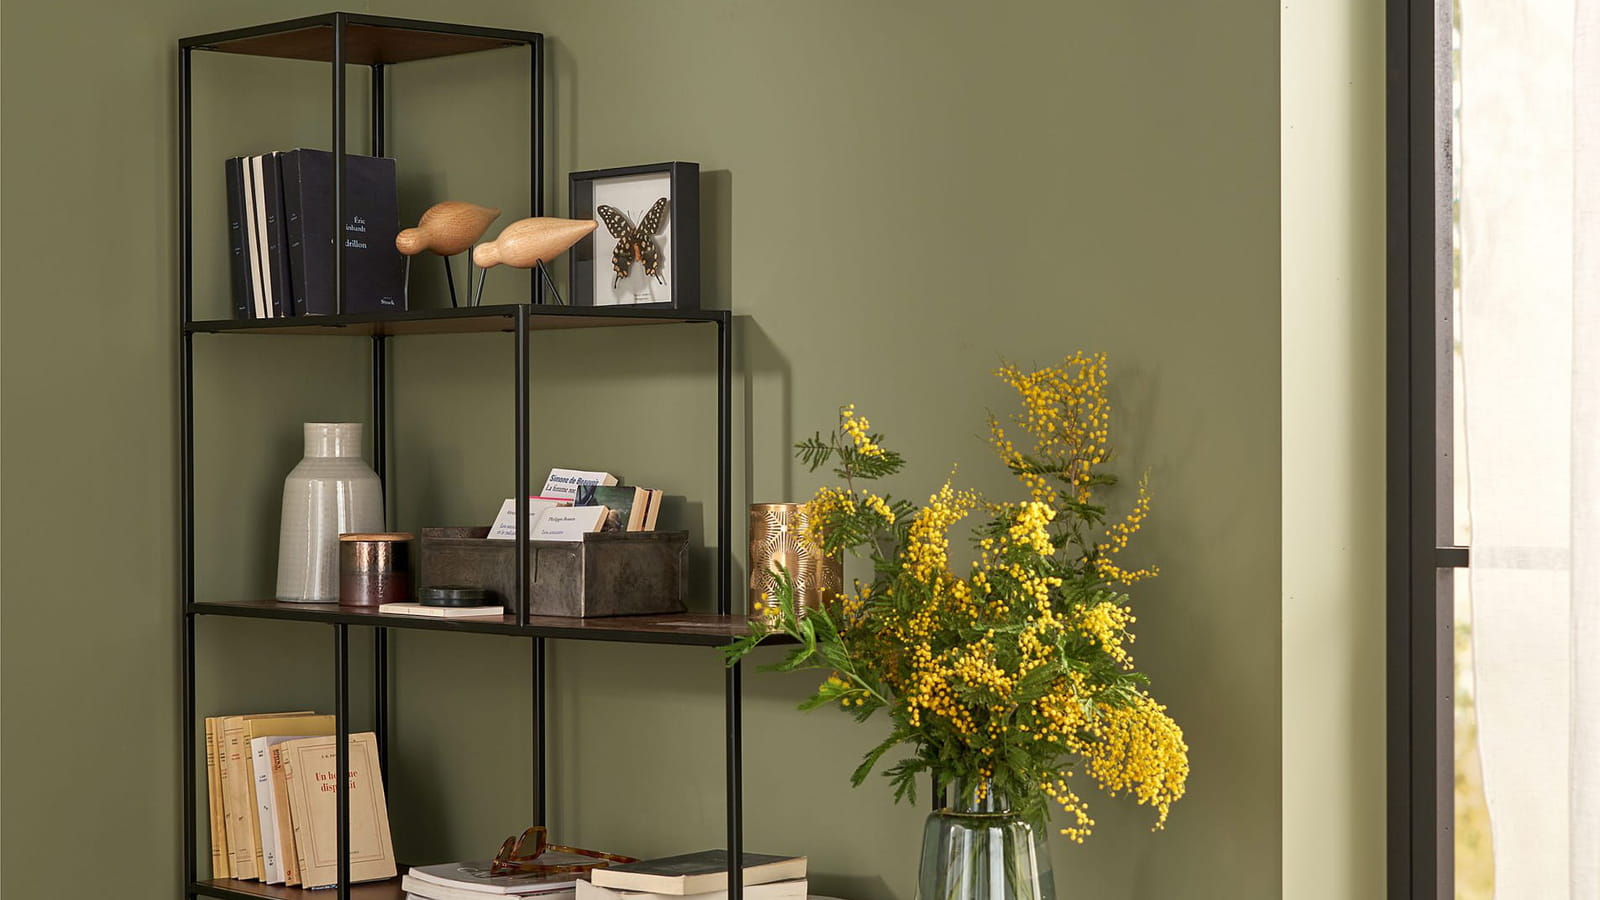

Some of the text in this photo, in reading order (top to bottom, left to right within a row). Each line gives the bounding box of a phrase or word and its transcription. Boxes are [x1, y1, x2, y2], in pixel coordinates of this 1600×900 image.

[549, 474, 568, 484] Simone
[570, 475, 577, 484] de
[315, 772, 327, 782] Un
